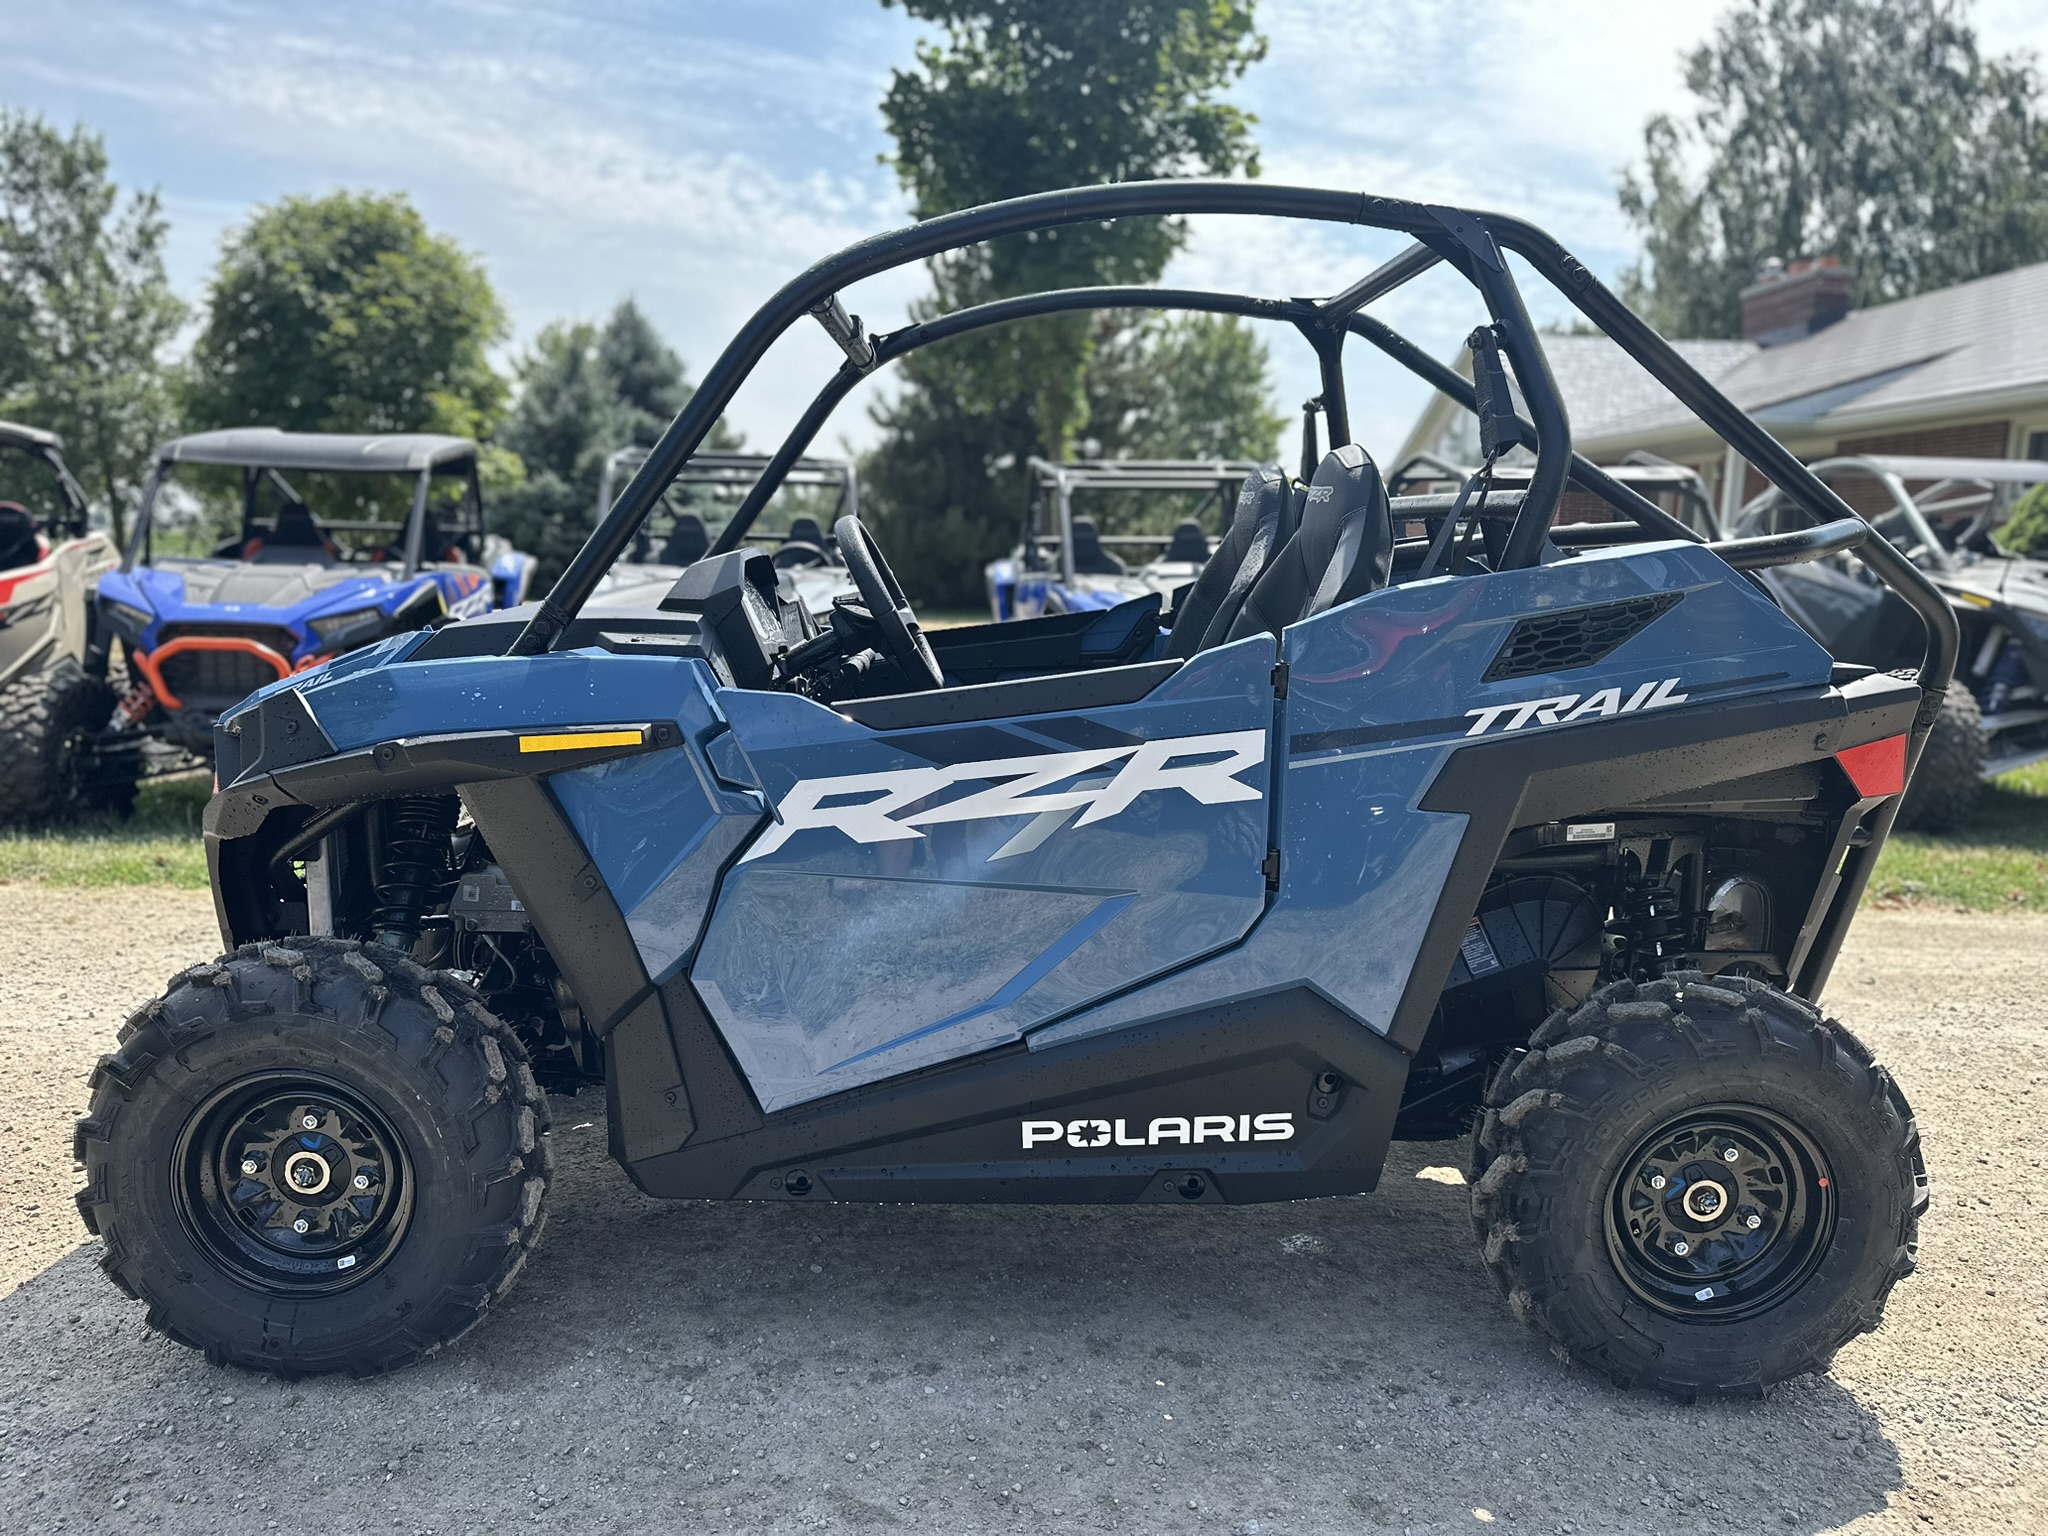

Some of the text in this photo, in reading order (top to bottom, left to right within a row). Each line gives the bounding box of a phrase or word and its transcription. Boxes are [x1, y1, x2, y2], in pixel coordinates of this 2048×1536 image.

[1464, 677, 1689, 736] TRAIL
[738, 728, 1265, 864] RZR
[1022, 1112, 1295, 1149] POLARIS
